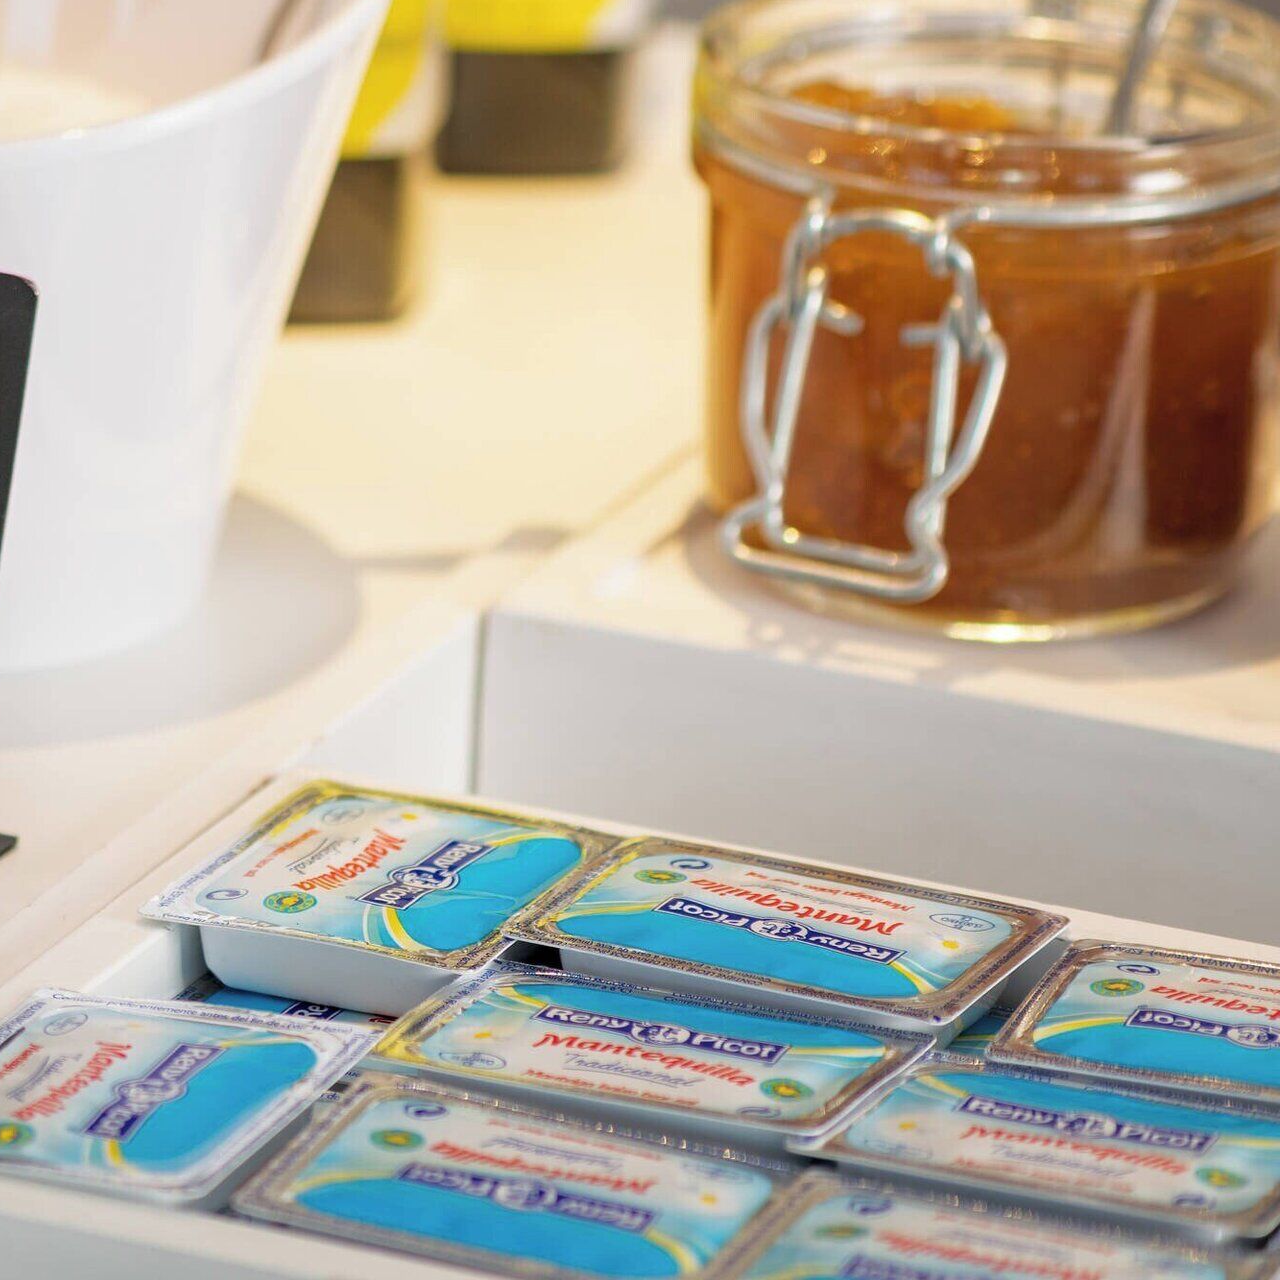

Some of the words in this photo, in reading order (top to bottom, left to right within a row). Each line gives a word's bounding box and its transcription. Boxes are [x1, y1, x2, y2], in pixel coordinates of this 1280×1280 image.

[293, 827, 406, 892] Mantequilla
[669, 901, 750, 927] Picot
[690, 879, 904, 935] Mantequilla
[810, 935, 891, 961] Reny
[544, 1007, 630, 1030] Reny
[690, 1031, 778, 1058] Picot
[1140, 1010, 1223, 1035] Picot
[10, 1041, 132, 1121] Mantequilla
[533, 1032, 755, 1087] Mantequilla
[968, 1098, 1053, 1125] Reny
[1120, 1124, 1205, 1148] Picot
[959, 1124, 1187, 1175] Mantequilla
